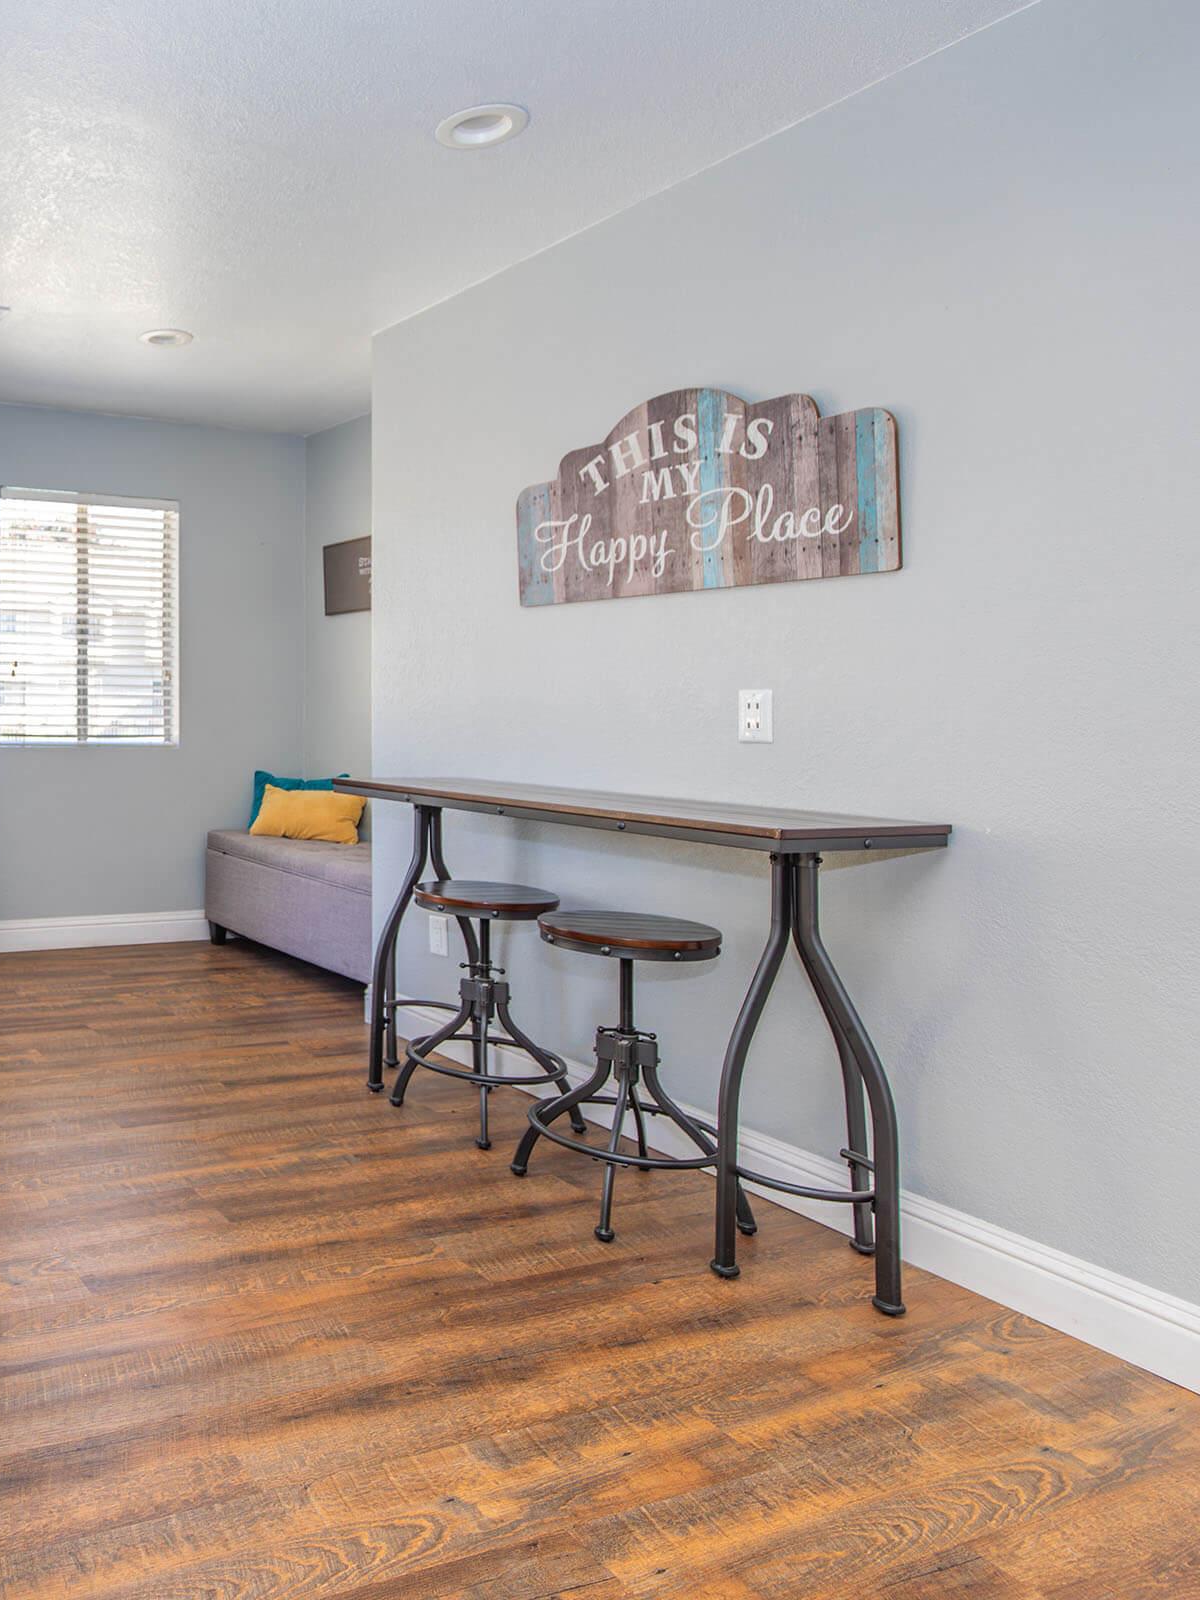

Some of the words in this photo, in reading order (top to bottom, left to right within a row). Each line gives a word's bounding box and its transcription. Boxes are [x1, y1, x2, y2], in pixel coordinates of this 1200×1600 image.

[578, 413, 699, 496] THIS
[714, 412, 774, 461] IS
[639, 459, 705, 503] MY
[534, 513, 676, 587] Happy
[686, 483, 854, 552] Place
